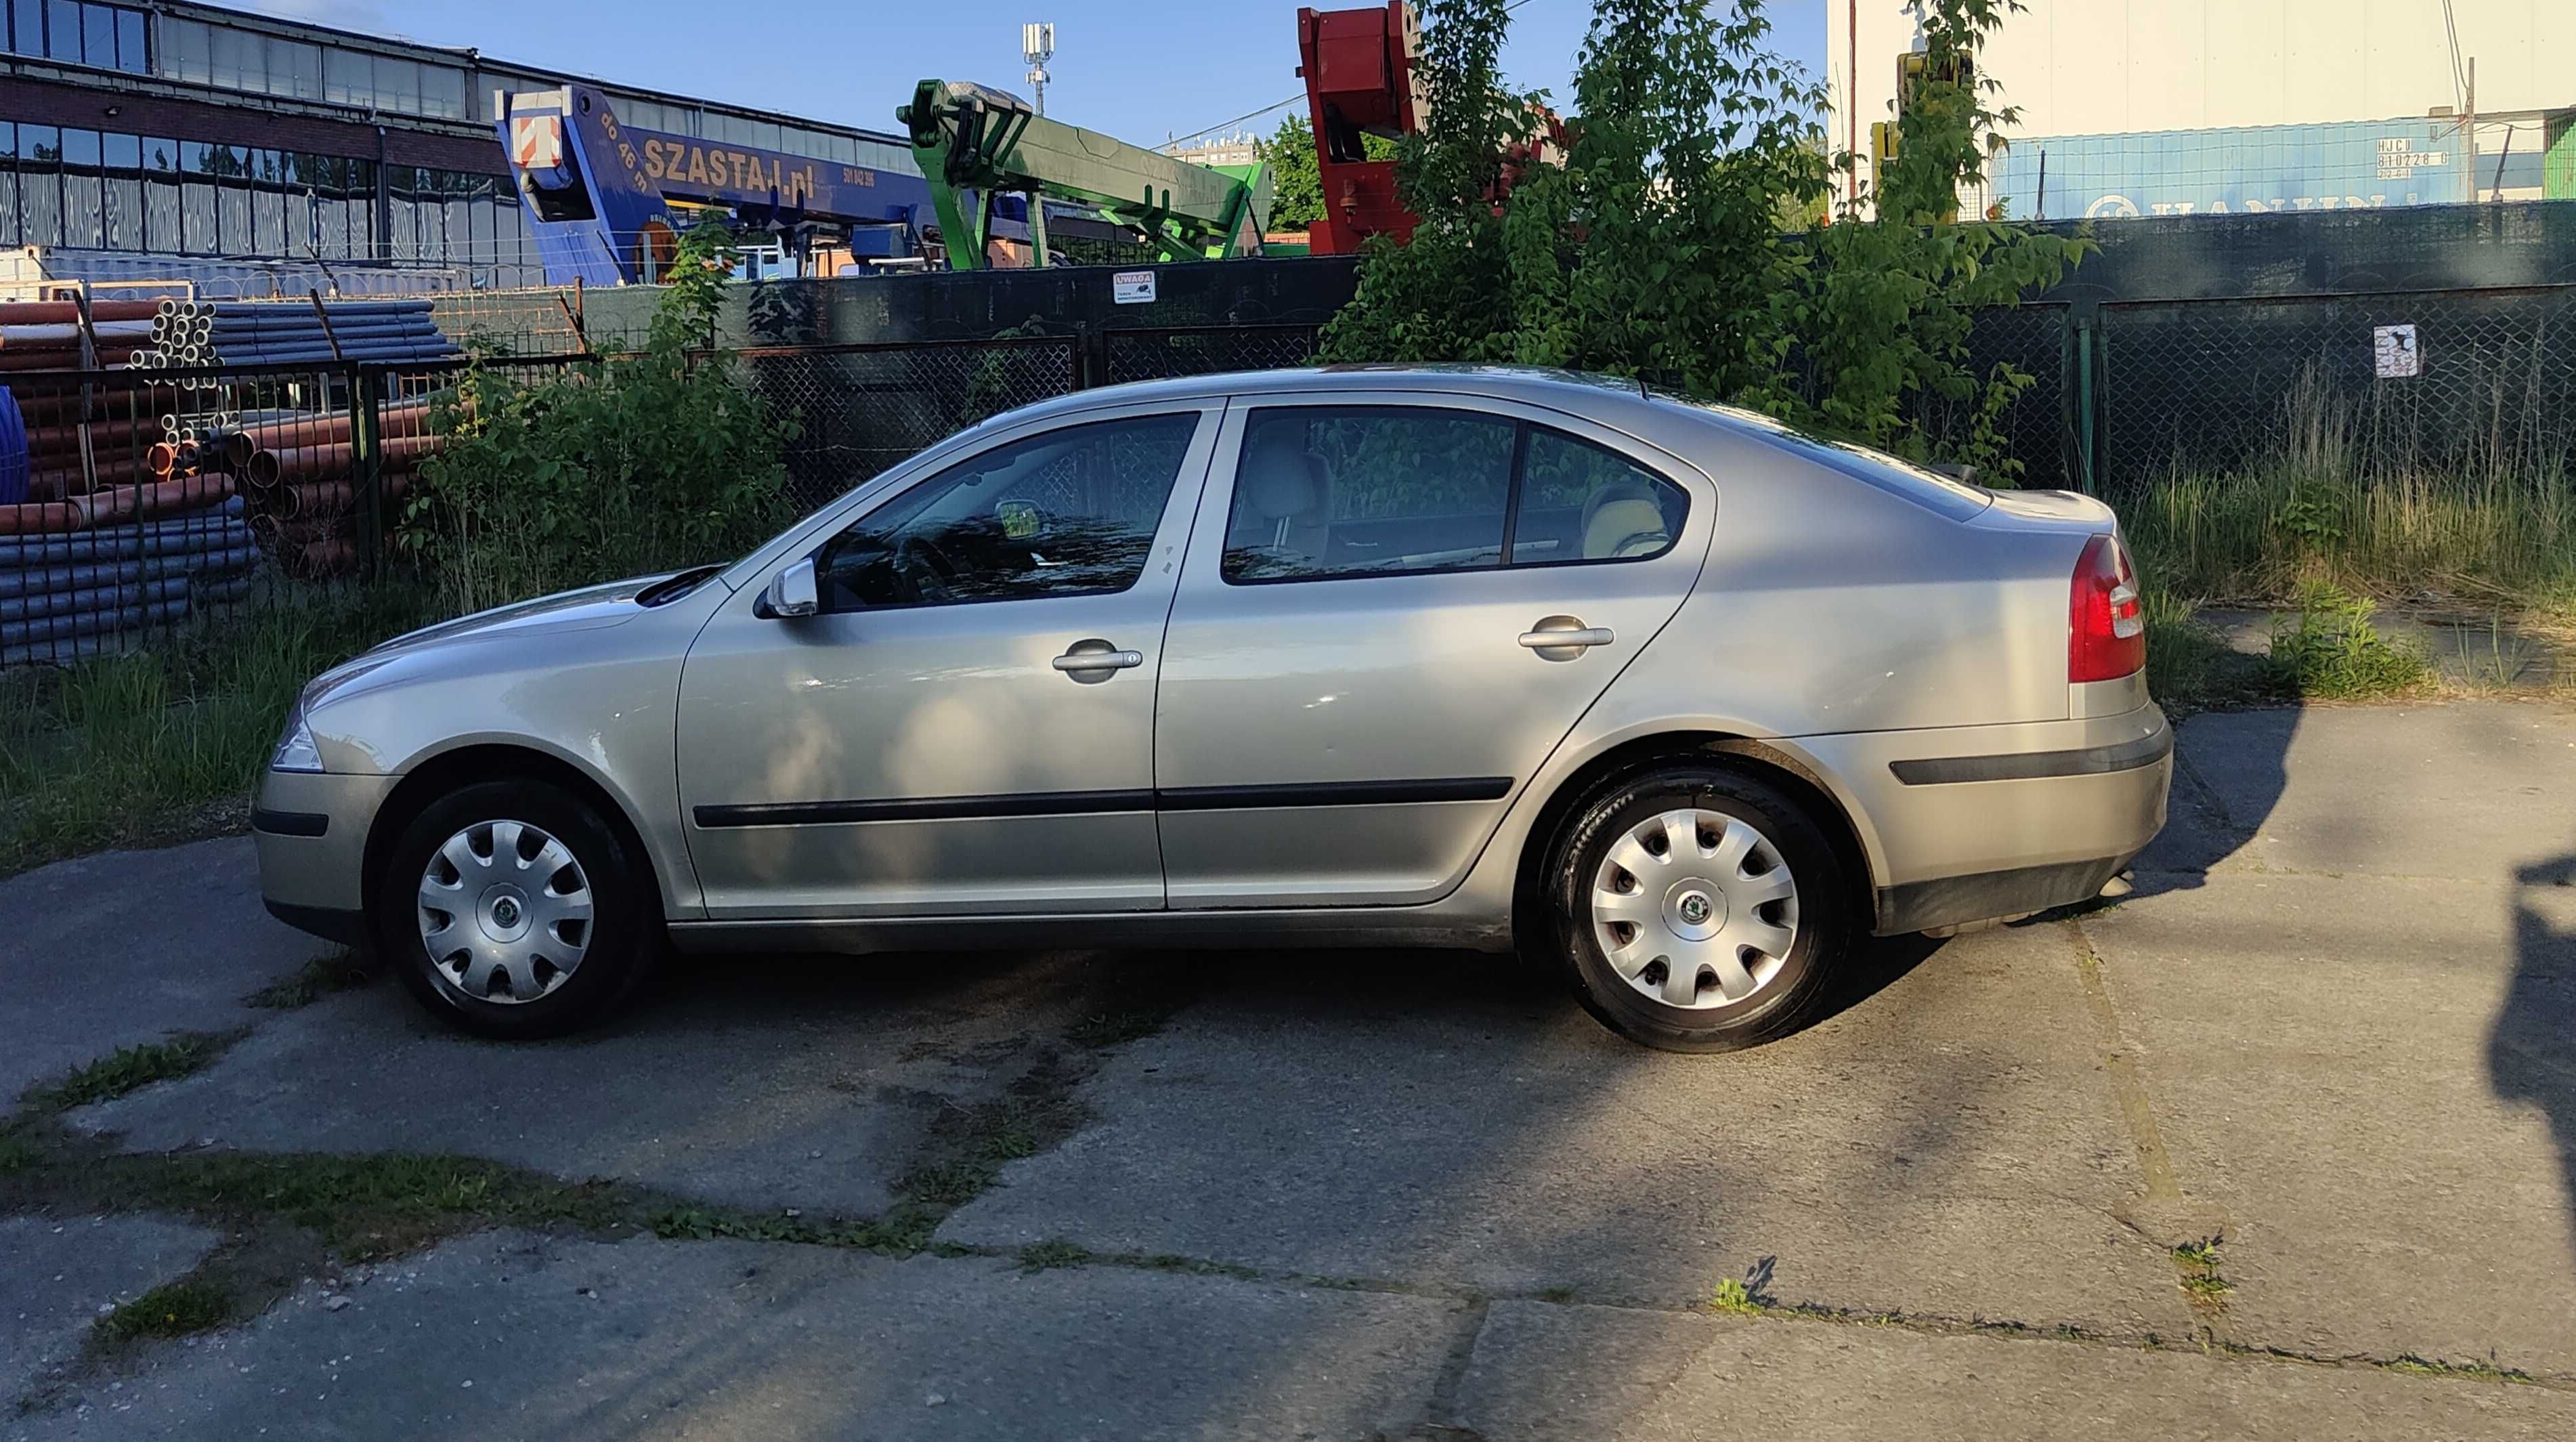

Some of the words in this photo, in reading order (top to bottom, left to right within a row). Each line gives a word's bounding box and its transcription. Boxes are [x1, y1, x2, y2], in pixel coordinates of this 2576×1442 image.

[601, 112, 618, 140] do
[618, 143, 636, 169] 46
[2378, 140, 2410, 152] HJCU
[2378, 153, 2429, 167] 810228
[645, 139, 813, 206] SZASTAJ.pl
[1117, 275, 1151, 283] UWAGA
